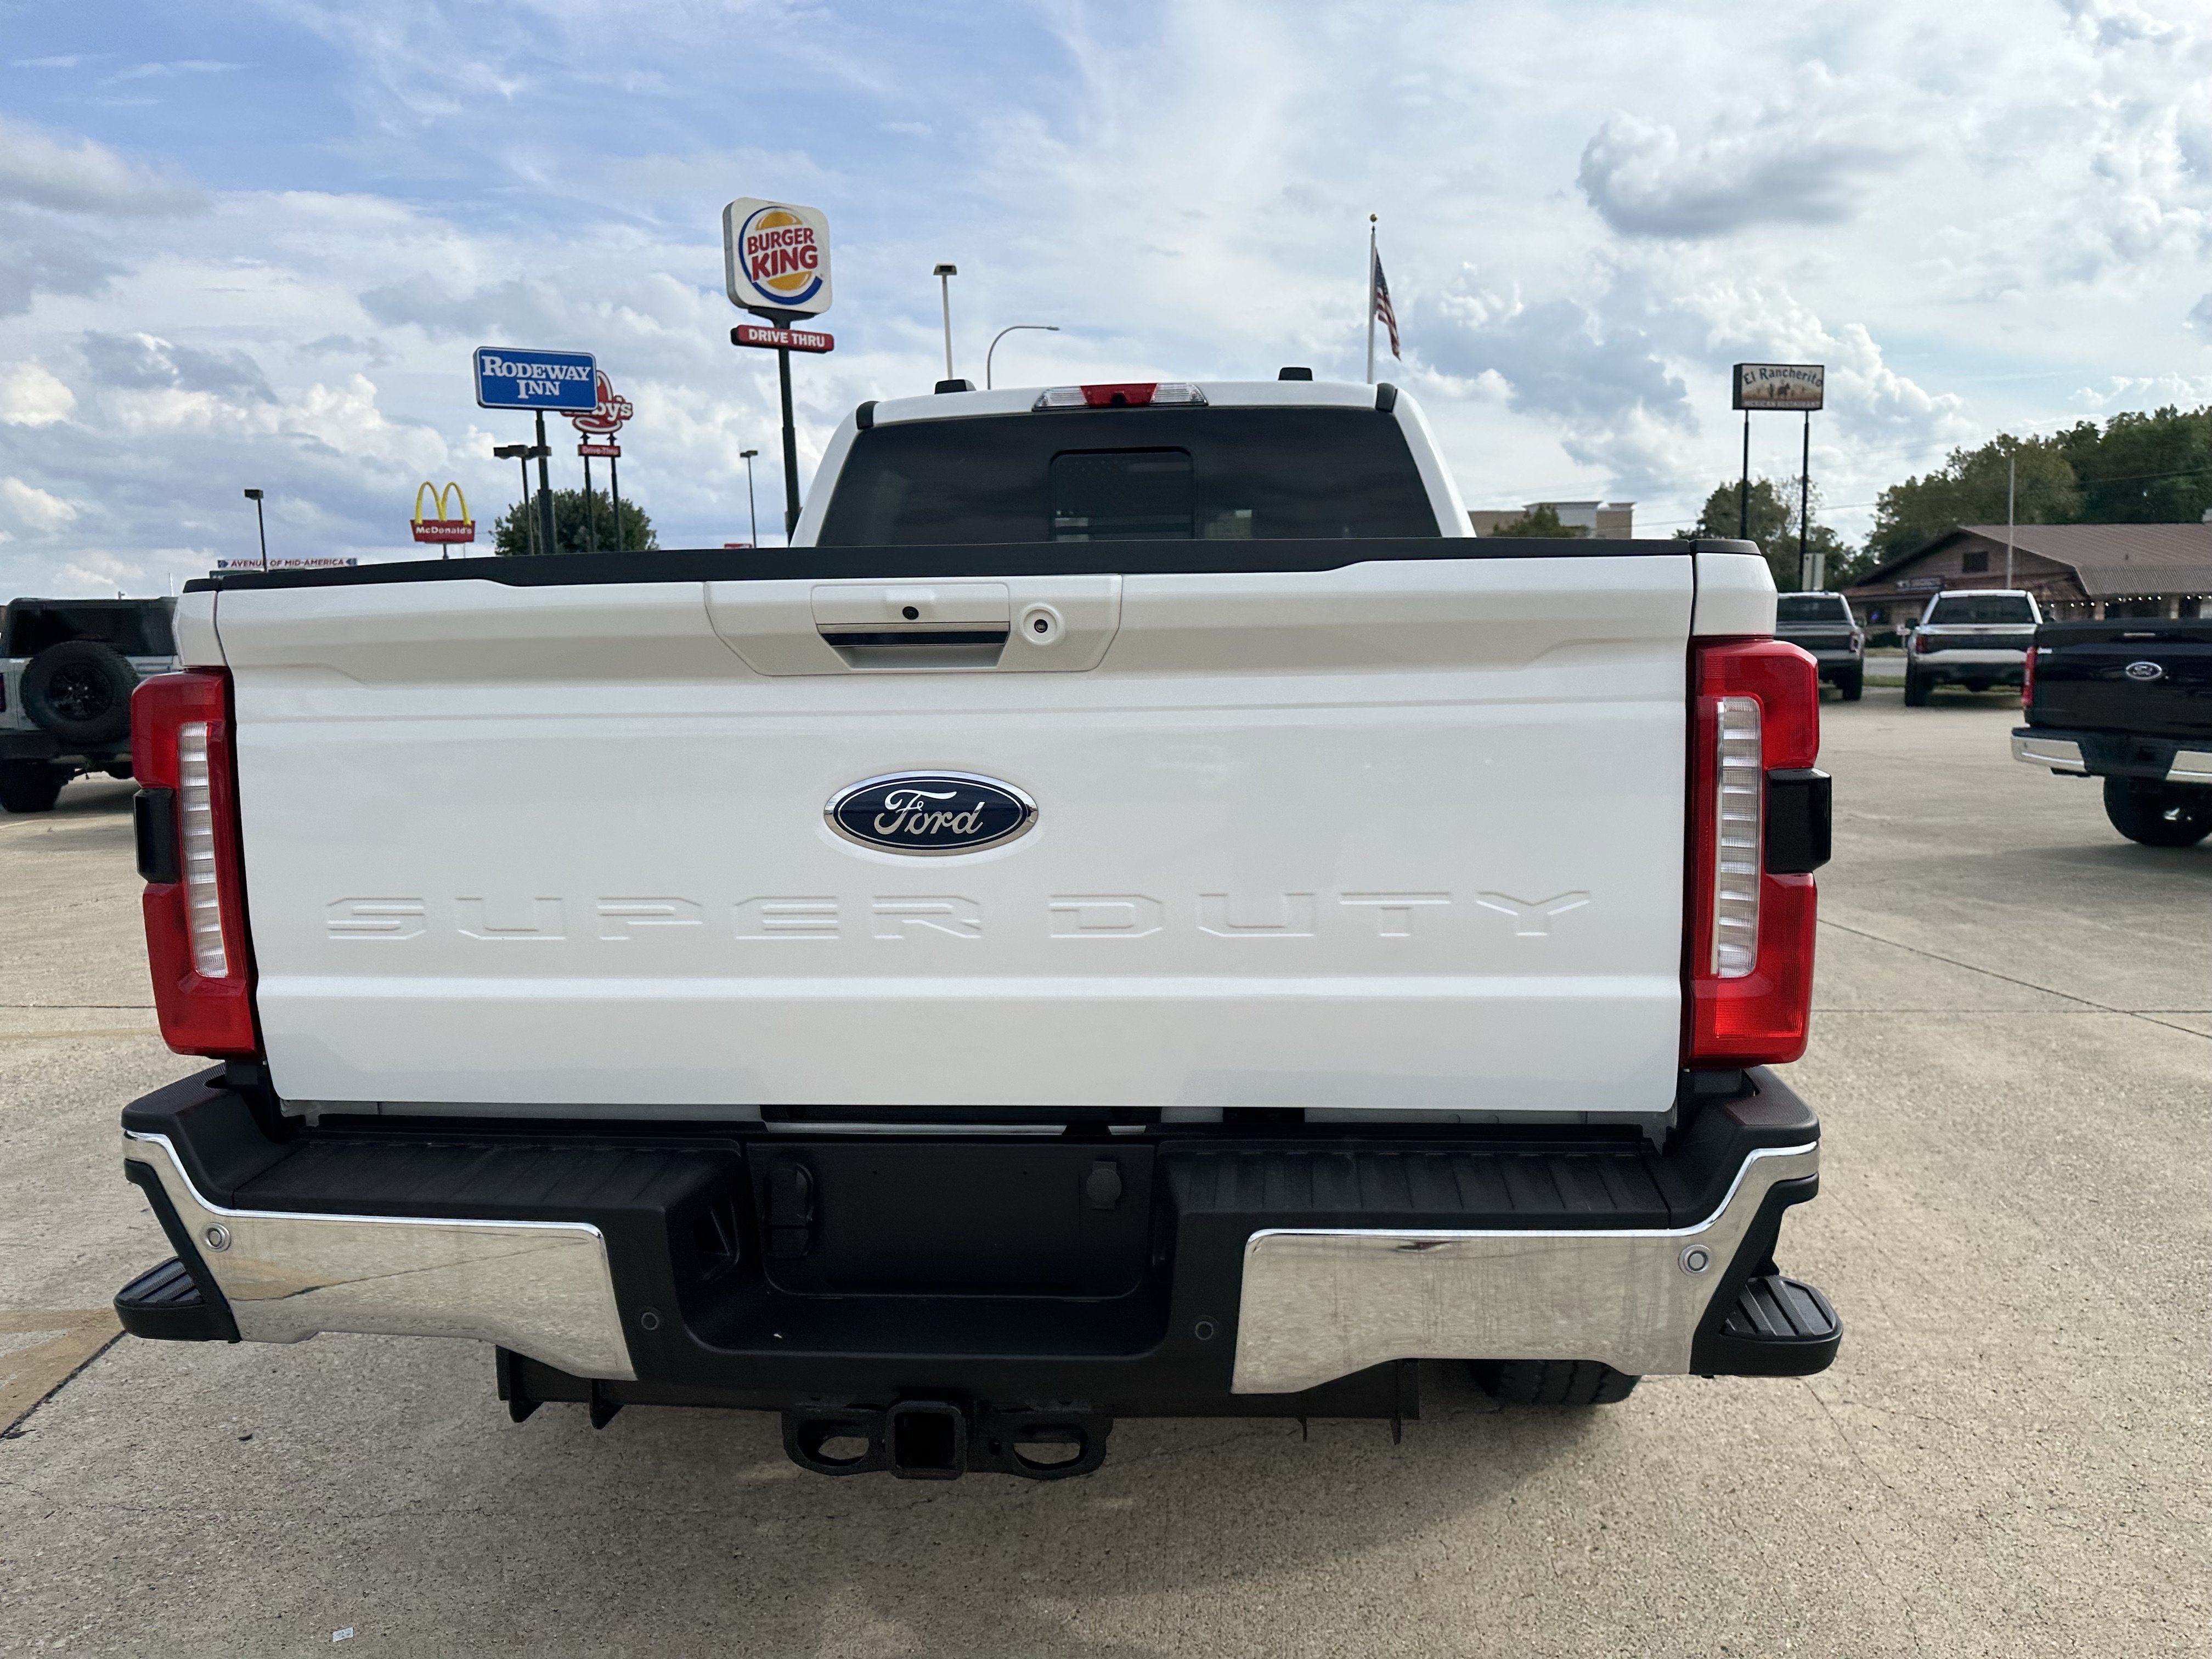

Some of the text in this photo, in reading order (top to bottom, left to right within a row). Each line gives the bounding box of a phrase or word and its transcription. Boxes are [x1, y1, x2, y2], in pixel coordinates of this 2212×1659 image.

[747, 228, 815, 256] BURGER
[751, 245, 819, 282] KING
[748, 329, 825, 348] DRIVE THRU
[481, 356, 591, 381] RODEWAY
[1743, 367, 1823, 387] El Rancherito
[516, 380, 561, 399] INN
[284, 558, 344, 566] MID-AMERICA
[873, 789, 985, 835] Ford
[326, 890, 1591, 940] SUPER DUTY
